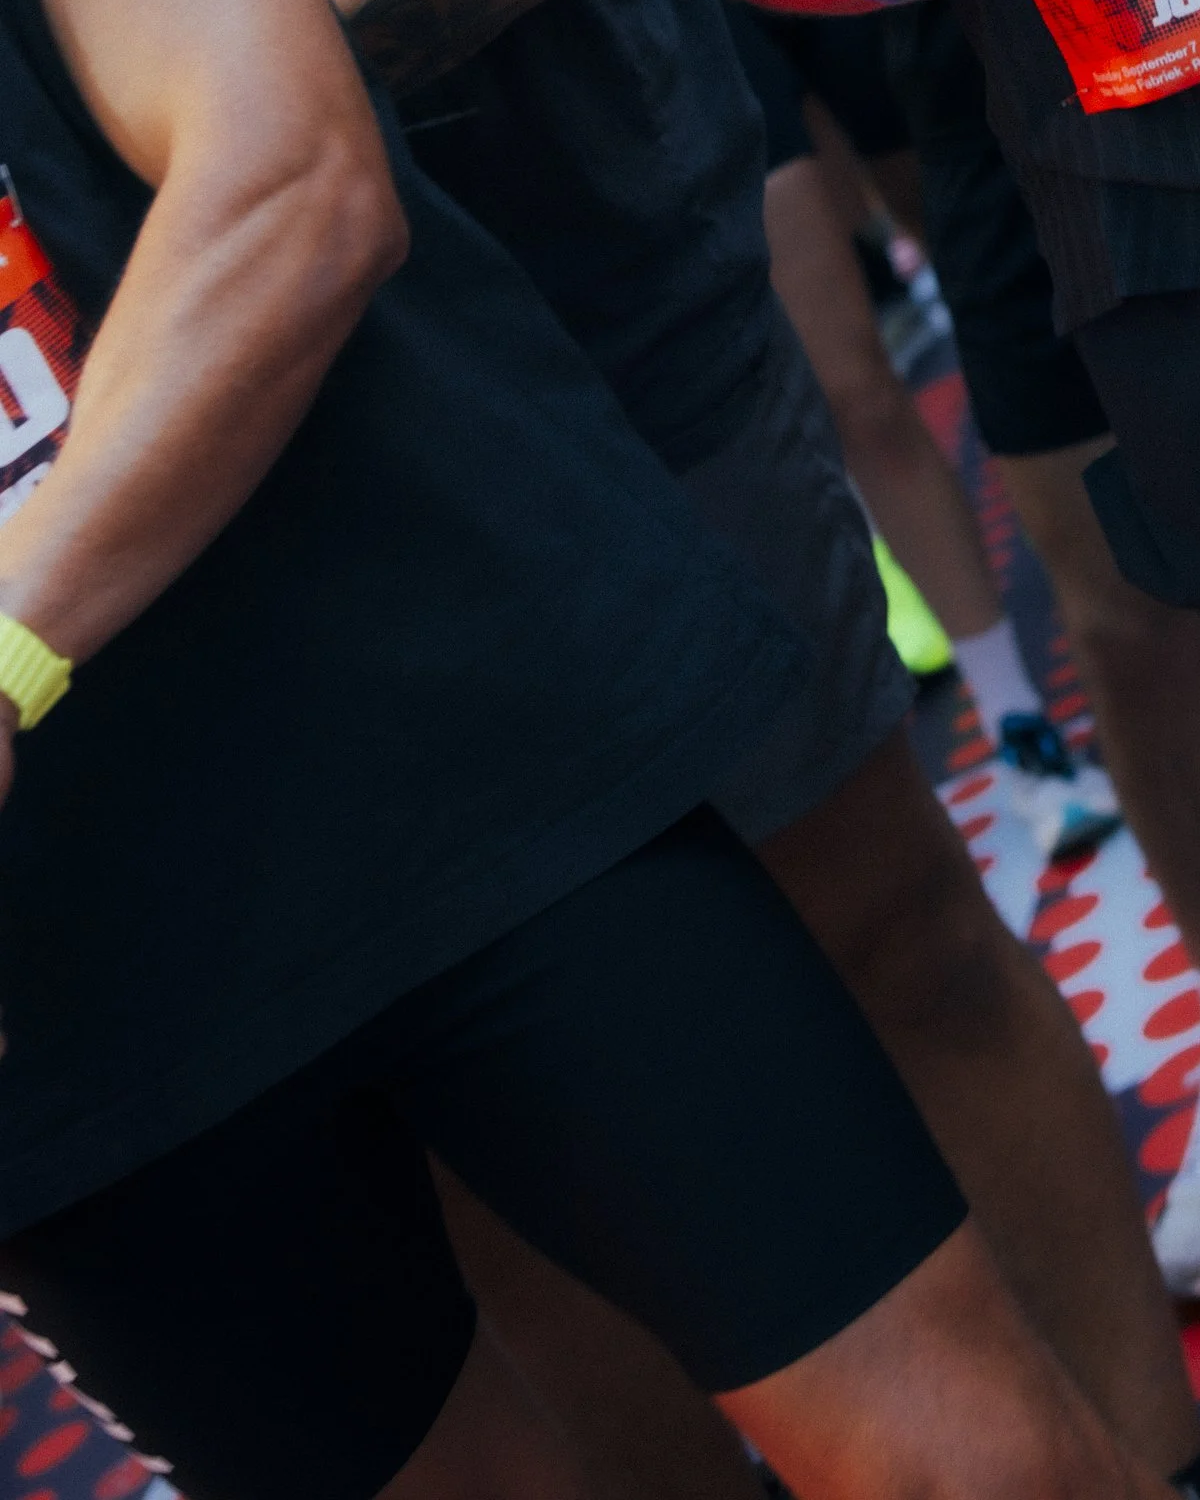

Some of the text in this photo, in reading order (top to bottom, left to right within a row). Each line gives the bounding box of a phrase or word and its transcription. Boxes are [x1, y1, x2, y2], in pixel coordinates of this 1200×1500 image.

[1121, 47, 1189, 78] September
[1188, 40, 1198, 53] 7
[1137, 67, 1184, 91] Fabriek
